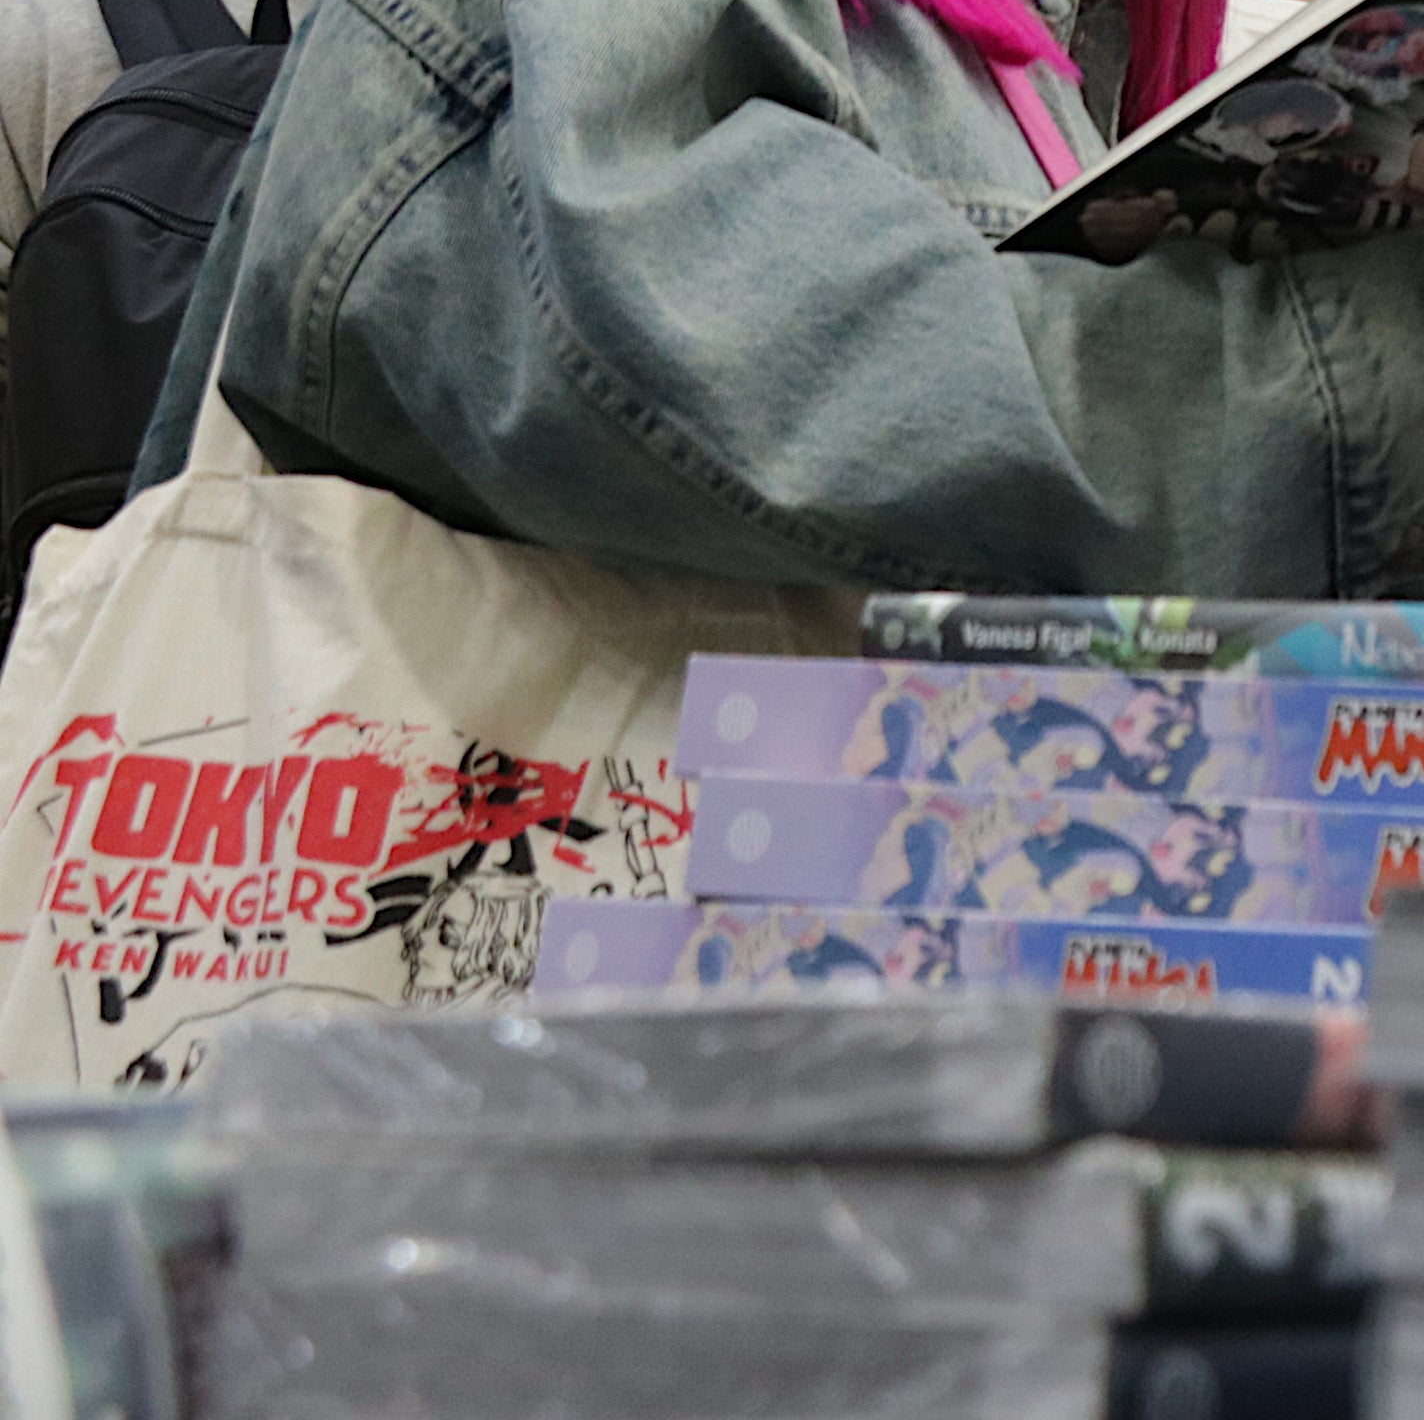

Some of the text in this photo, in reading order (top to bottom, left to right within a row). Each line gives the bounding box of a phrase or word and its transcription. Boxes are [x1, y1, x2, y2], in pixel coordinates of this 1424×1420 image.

[54, 752, 404, 868] TOKYO
[38, 859, 369, 927] EVENGERS
[54, 938, 290, 981] KEN WAKUI
